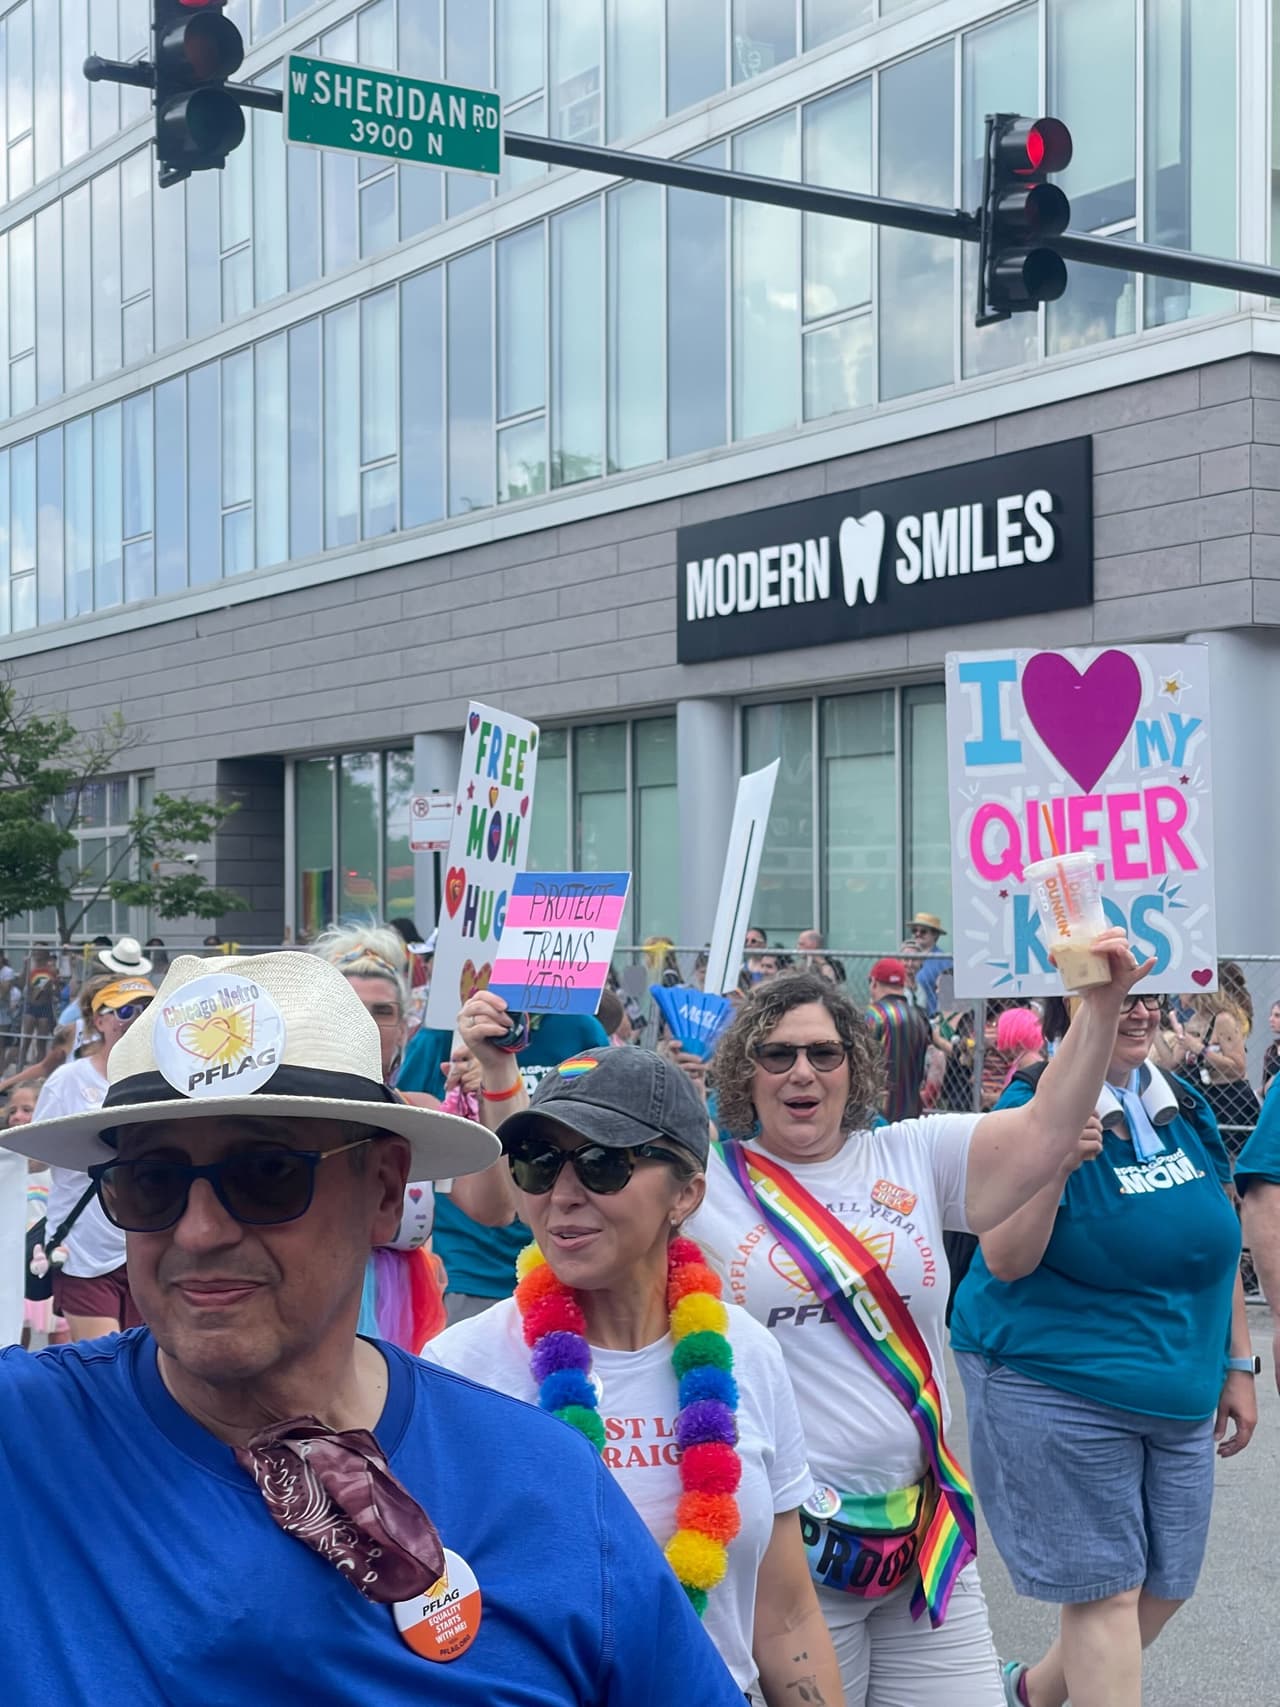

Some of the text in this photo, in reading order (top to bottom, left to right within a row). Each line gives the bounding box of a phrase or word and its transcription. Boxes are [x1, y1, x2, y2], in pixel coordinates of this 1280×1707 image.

[291, 70, 498, 130] W SHERIDAN RD
[350, 118, 443, 157] 3900 N
[686, 489, 1055, 621] MODERN SMILES
[958, 659, 1203, 768] I MY
[475, 721, 528, 791] FREE
[466, 804, 520, 866] MOM
[969, 785, 1199, 884] QUEER
[530, 882, 616, 922] PROTECT
[523, 931, 595, 972] TRANS
[163, 984, 259, 1028] Chicago Metro
[520, 971, 575, 1011] KIDS
[188, 1047, 276, 1092] PFLAG
[1118, 1156, 1198, 1194] MOM
[731, 1223, 768, 1305] #PFLAGP
[869, 1205, 916, 1235] YEAR
[914, 1236, 936, 1288] LONG
[754, 1179, 893, 1341] FLAG
[605, 1417, 646, 1440] ST
[602, 1443, 683, 1468] RAIG
[422, 1589, 460, 1616] PFLAG
[428, 1603, 461, 1627] EQUALITY
[435, 1615, 462, 1634] STARTS
[435, 1629, 455, 1645] WITH
